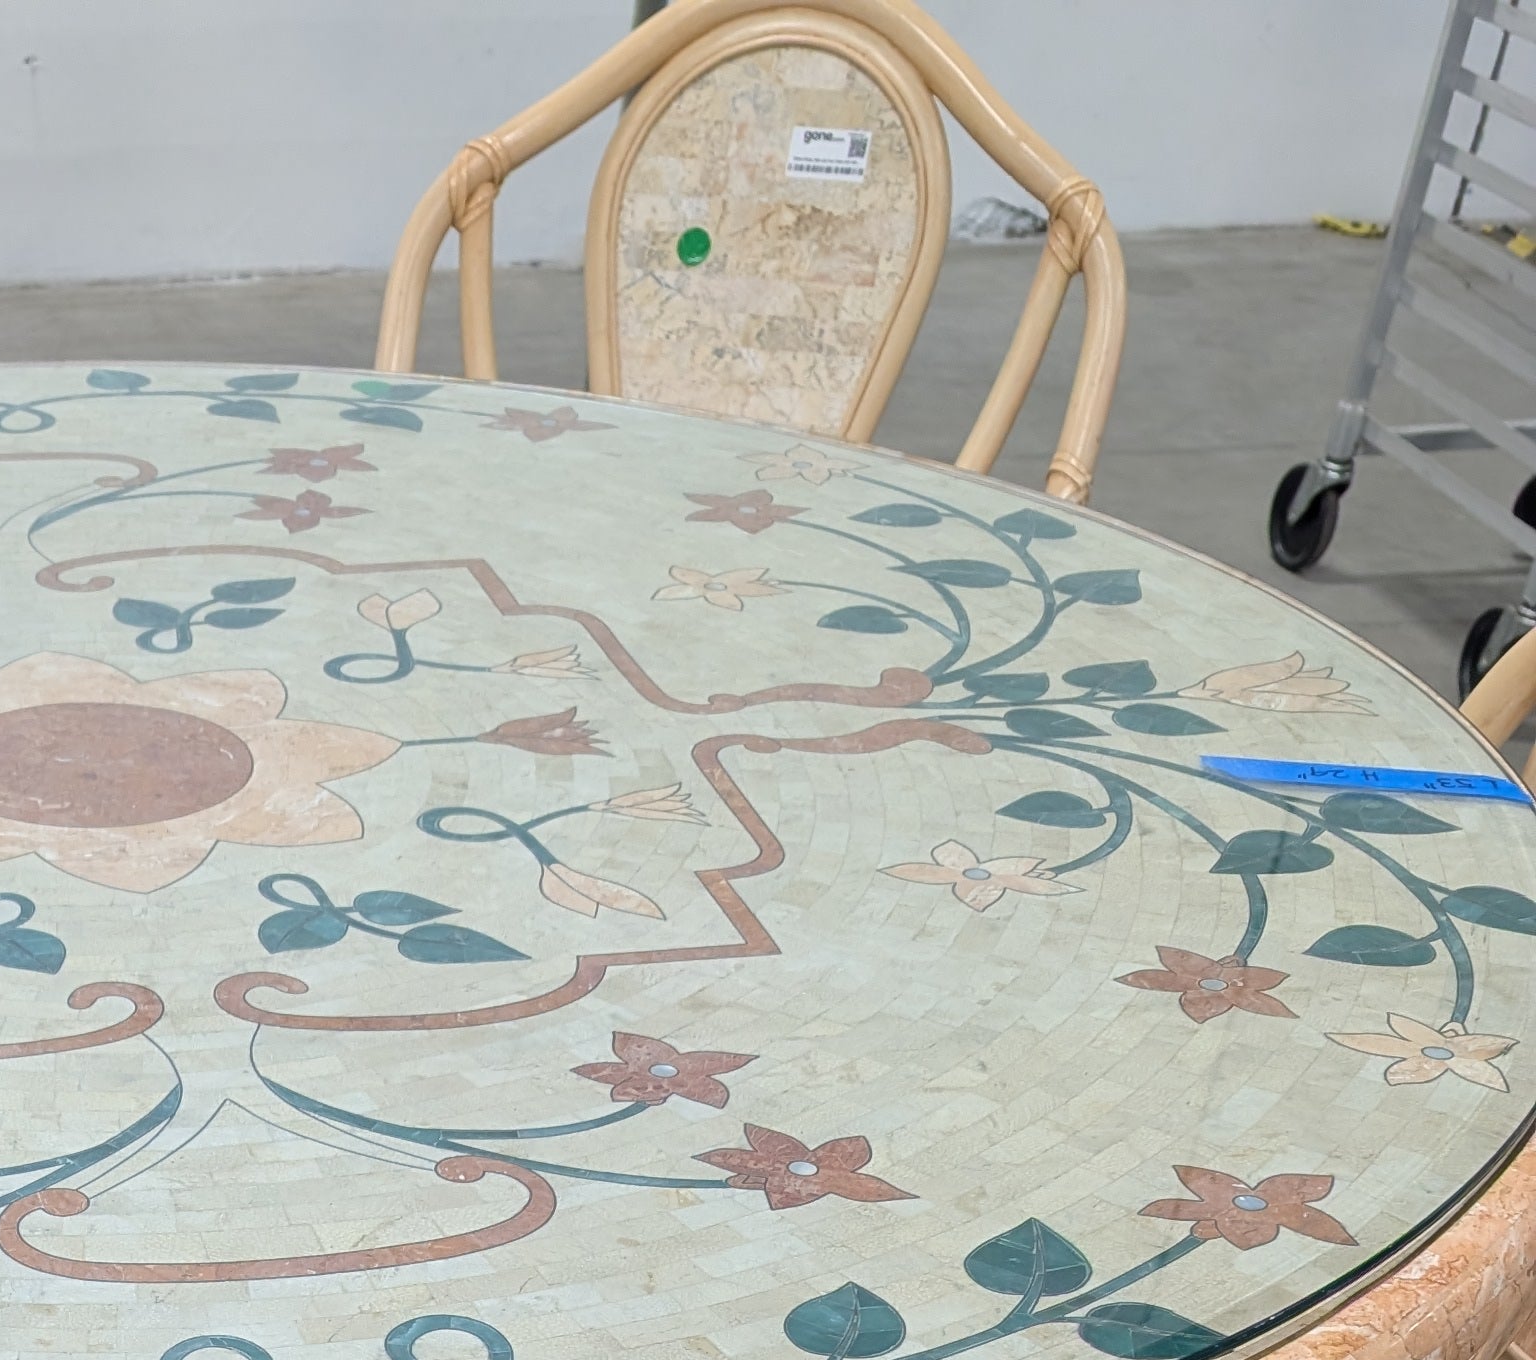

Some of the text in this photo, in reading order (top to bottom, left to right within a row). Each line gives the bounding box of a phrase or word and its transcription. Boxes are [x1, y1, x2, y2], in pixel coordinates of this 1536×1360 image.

[1297, 766, 1498, 790] L 53" H 29"
